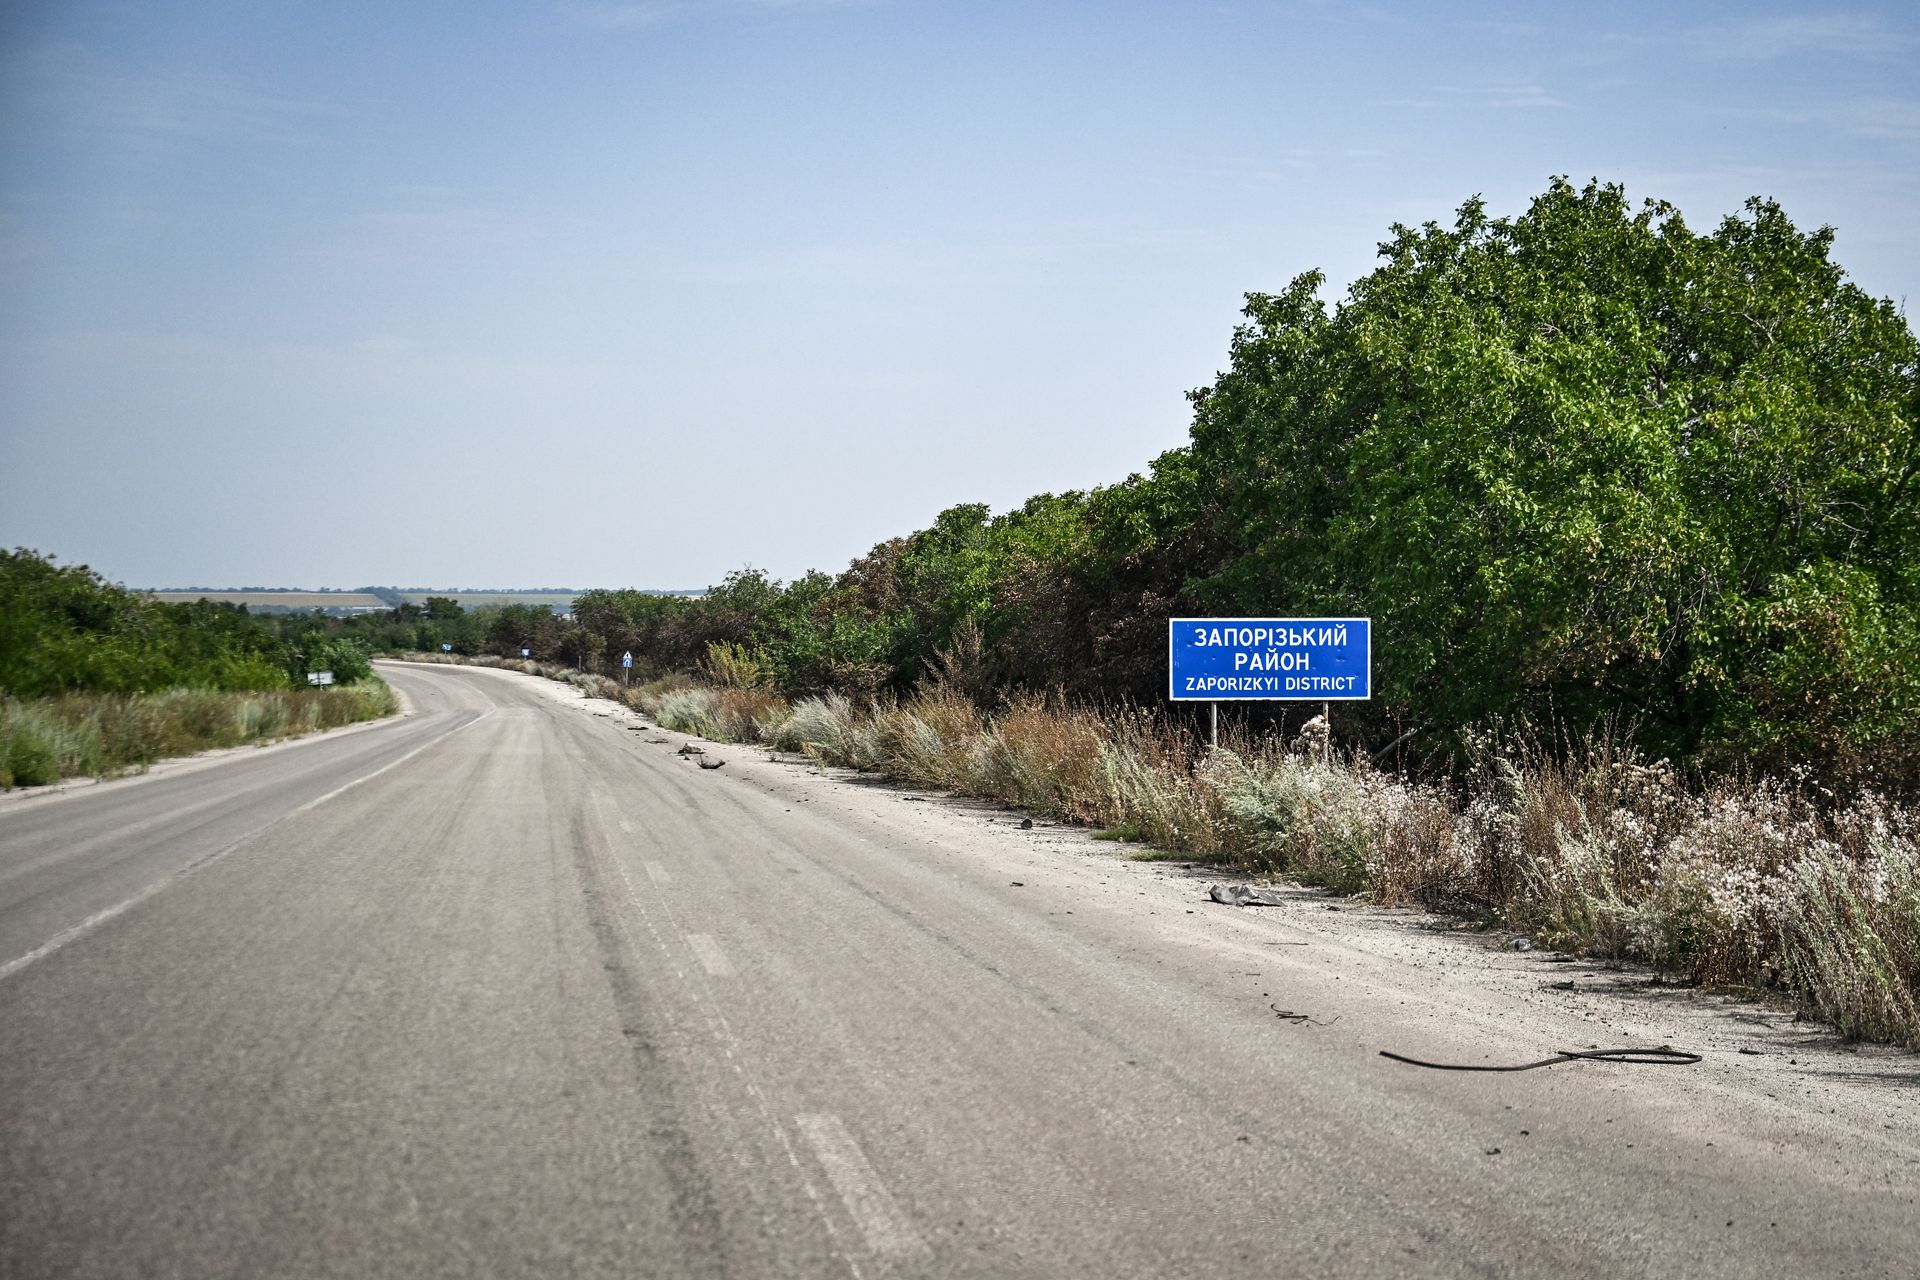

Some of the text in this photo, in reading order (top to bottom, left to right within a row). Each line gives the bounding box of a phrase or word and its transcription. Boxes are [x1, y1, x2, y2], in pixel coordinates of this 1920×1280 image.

[1194, 623, 1347, 646] ЗАПОРІЗЬКИЙ
[1235, 647, 1309, 671] РАЙОН
[1185, 676, 1356, 691] ZAPORIZKYI DISTRICT
